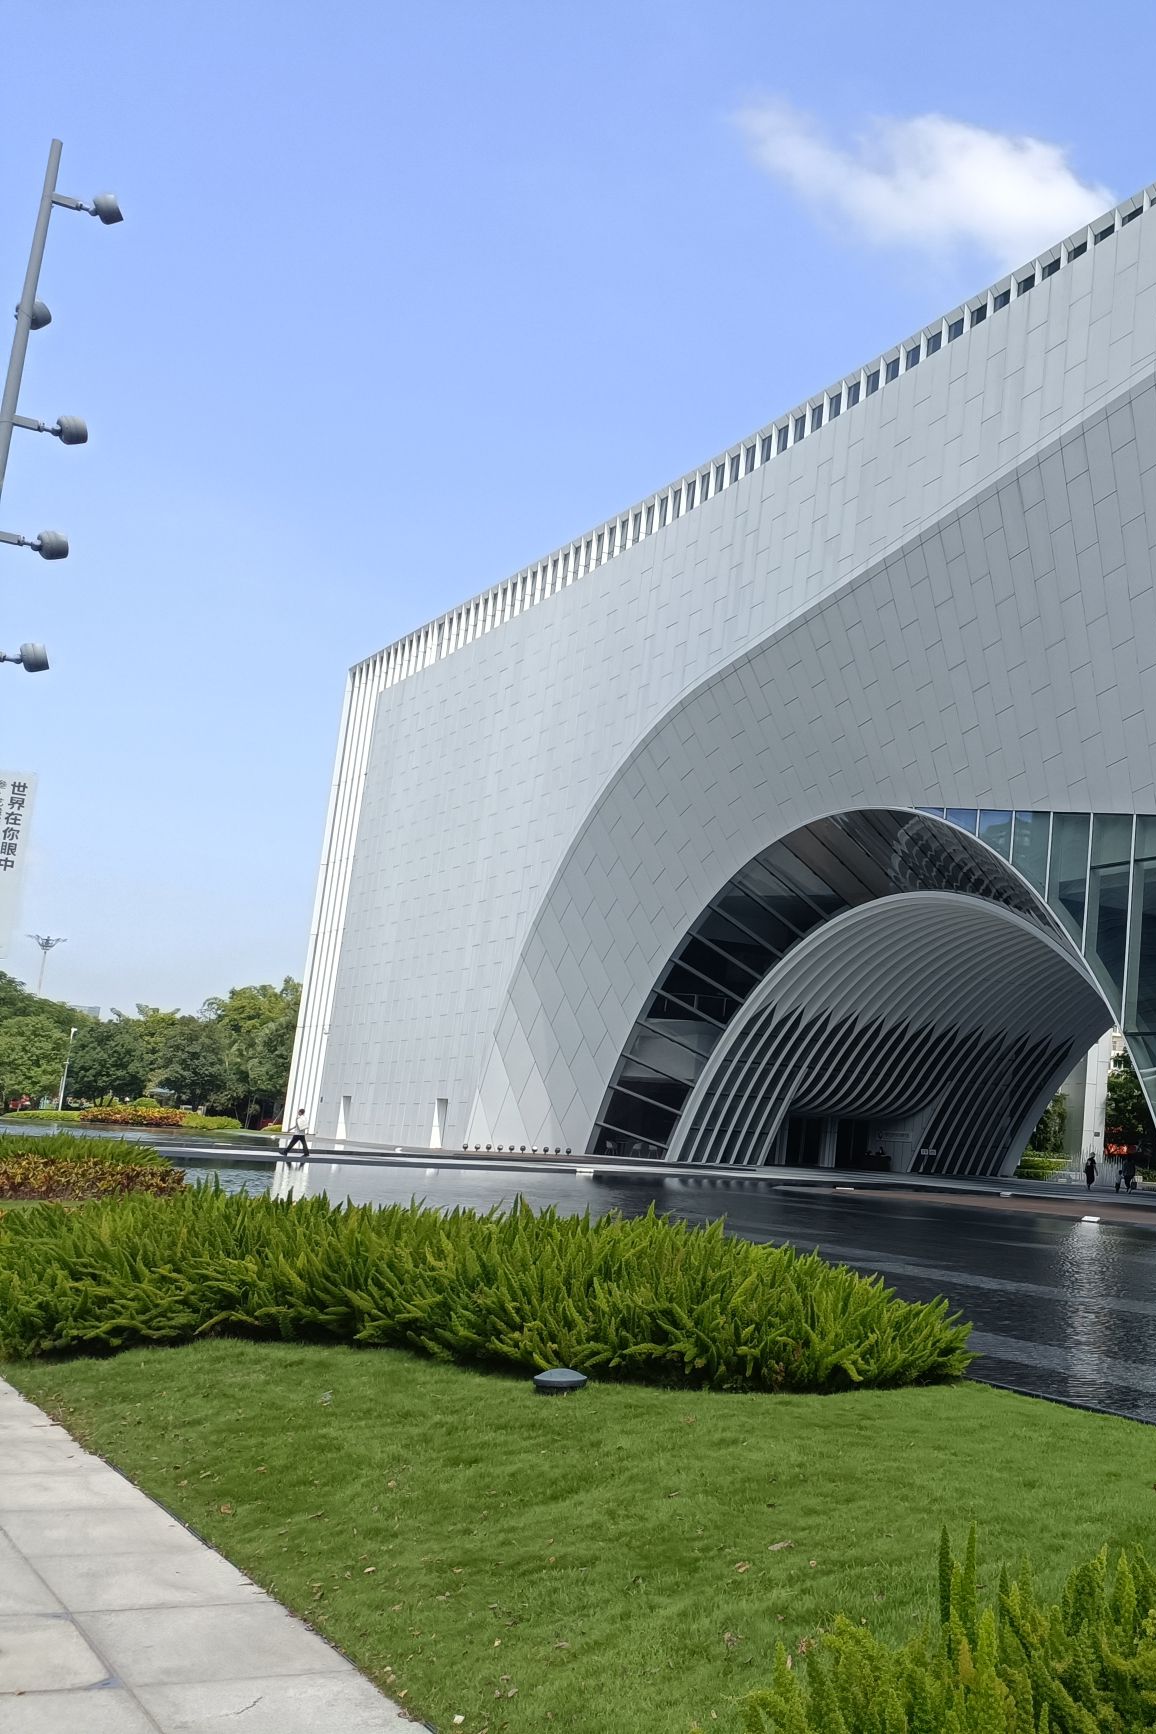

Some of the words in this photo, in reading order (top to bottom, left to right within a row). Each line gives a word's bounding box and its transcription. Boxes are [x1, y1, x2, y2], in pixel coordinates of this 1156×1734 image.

[0, 781, 28, 872] 世界在你眼中
